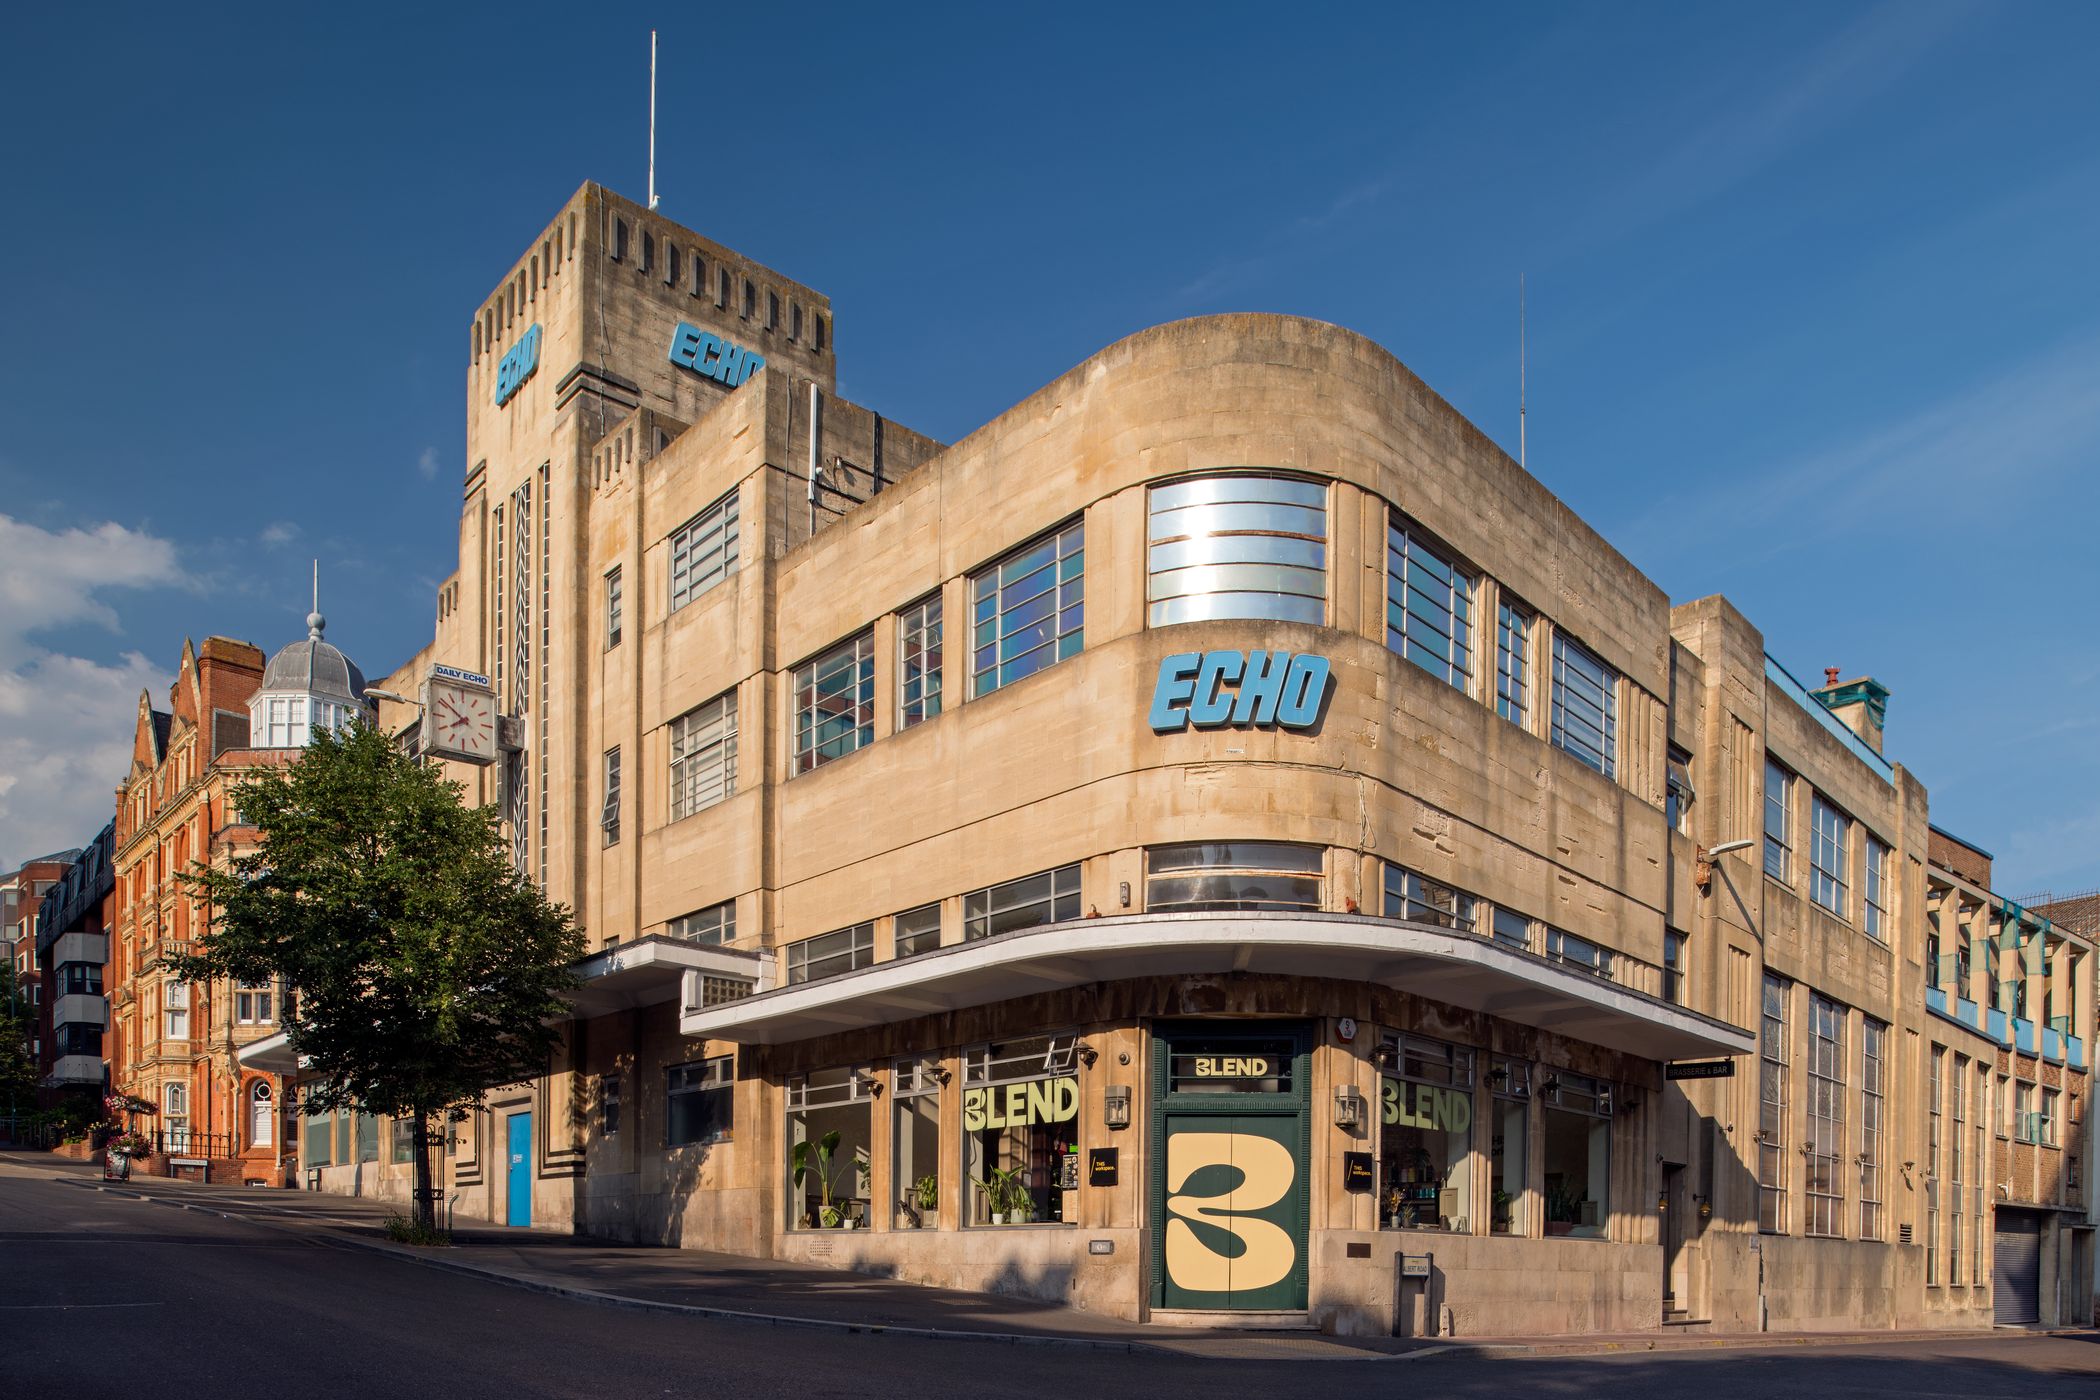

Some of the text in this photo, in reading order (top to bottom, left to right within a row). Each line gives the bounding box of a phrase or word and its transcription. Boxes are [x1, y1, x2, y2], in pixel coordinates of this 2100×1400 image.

[495, 322, 542, 407] ECHO
[436, 666, 488, 685] DAILY ECHO
[1148, 649, 1331, 731] ECHO
[1195, 1057, 1268, 1078] BLEND
[1668, 1066, 1706, 1077] BRASSERIE
[1712, 1065, 1728, 1075] BAR
[964, 1075, 1079, 1132] BLEND
[1381, 1077, 1471, 1134] BLEND
